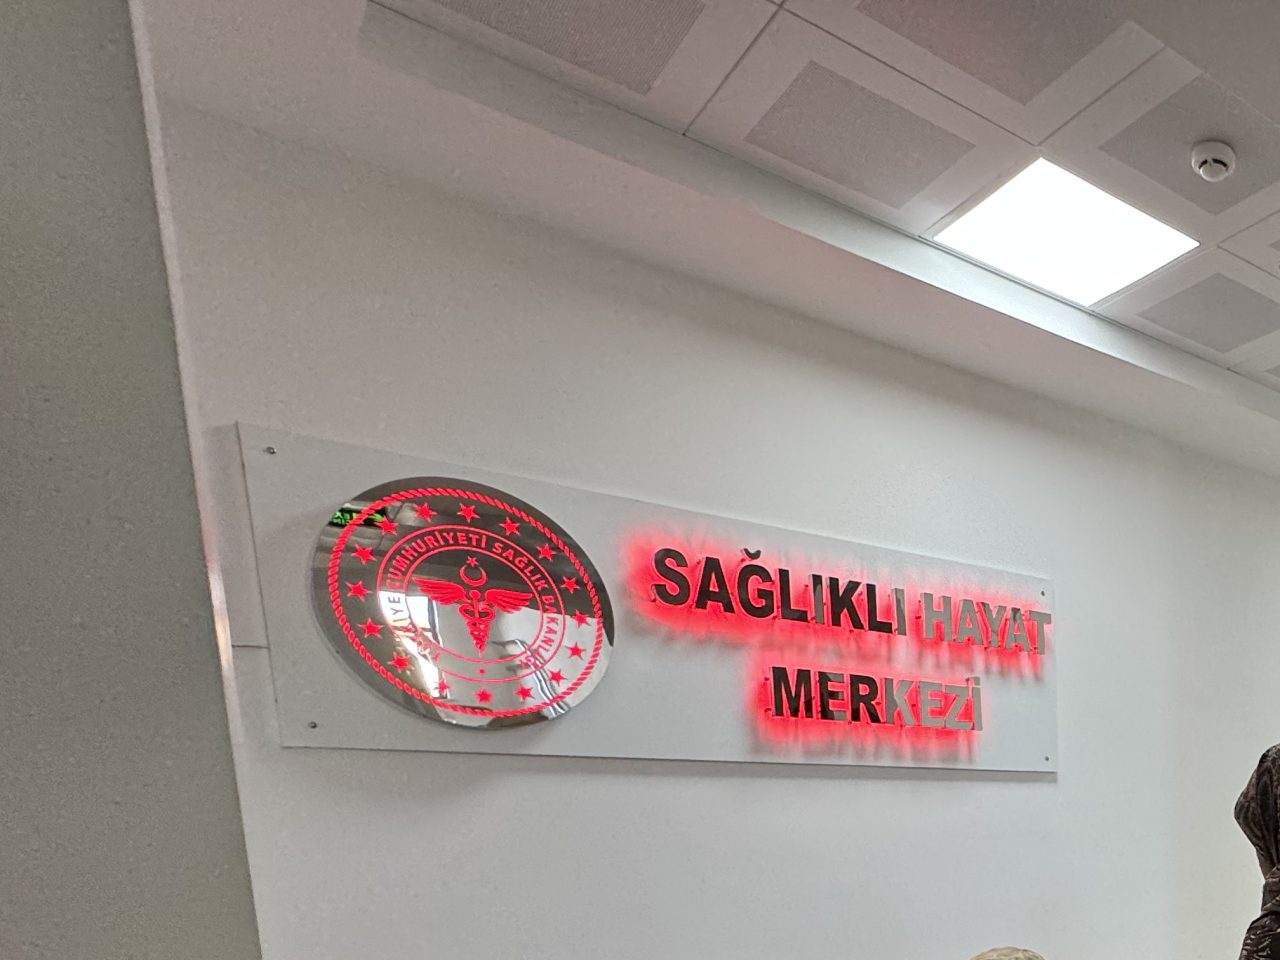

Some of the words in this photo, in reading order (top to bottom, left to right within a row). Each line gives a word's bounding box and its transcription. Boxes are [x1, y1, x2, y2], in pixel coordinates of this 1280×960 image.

[386, 531, 487, 589] CUMHURİYETİ
[491, 542, 550, 592] SAĞLIK
[651, 547, 907, 637] SAĞLIKLI
[920, 591, 1052, 656] HAYAT
[768, 665, 984, 732] MERKEZİ
